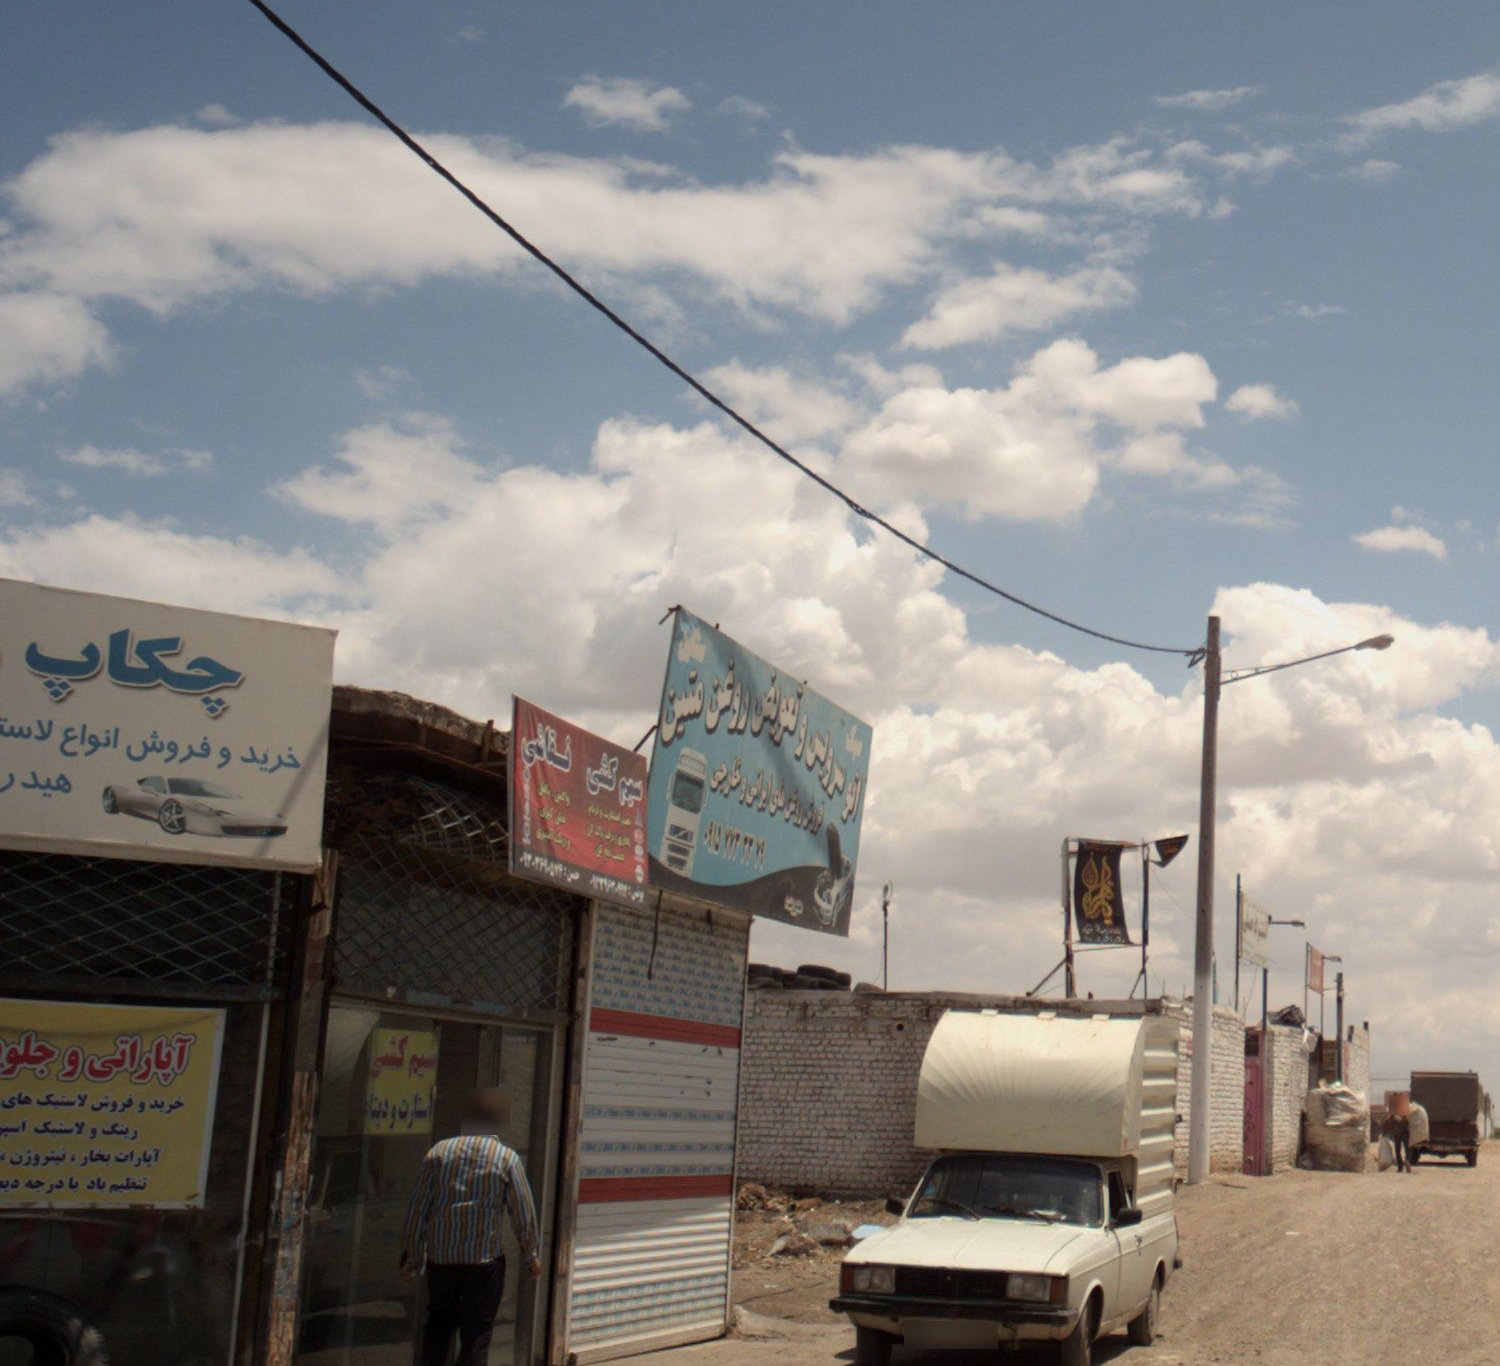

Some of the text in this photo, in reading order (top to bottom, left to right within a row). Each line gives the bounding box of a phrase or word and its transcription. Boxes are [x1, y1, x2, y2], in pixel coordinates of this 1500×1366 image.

[26, 629, 245, 716] چکاپ
[706, 658, 751, 734] روغن
[751, 668, 803, 747] تعویض
[59, 723, 119, 757] انواع
[126, 731, 211, 762] فروش
[521, 723, 572, 773] نقاشی
[794, 714, 808, 760] و
[217, 747, 231, 768] و
[240, 746, 301, 773] خرید
[805, 731, 847, 799] سرویس
[586, 752, 619, 795] کشی
[60, 1046, 81, 1080] و
[87, 1034, 195, 1085] آپاراتی
[2, 1092, 185, 1114] خرید و فروش لاستیک های
[34, 1120, 85, 1138] لاستیک
[89, 1125, 98, 1140] و
[102, 1122, 138, 1140] رینگ
[10, 1147, 66, 1167] نیتروژن
[80, 1148, 111, 1167] بخار
[24, 1179, 63, 1195] درجه
[69, 1176, 79, 1193] با
[87, 1177, 106, 1193] باد
[109, 1177, 148, 1194] تنظیم
